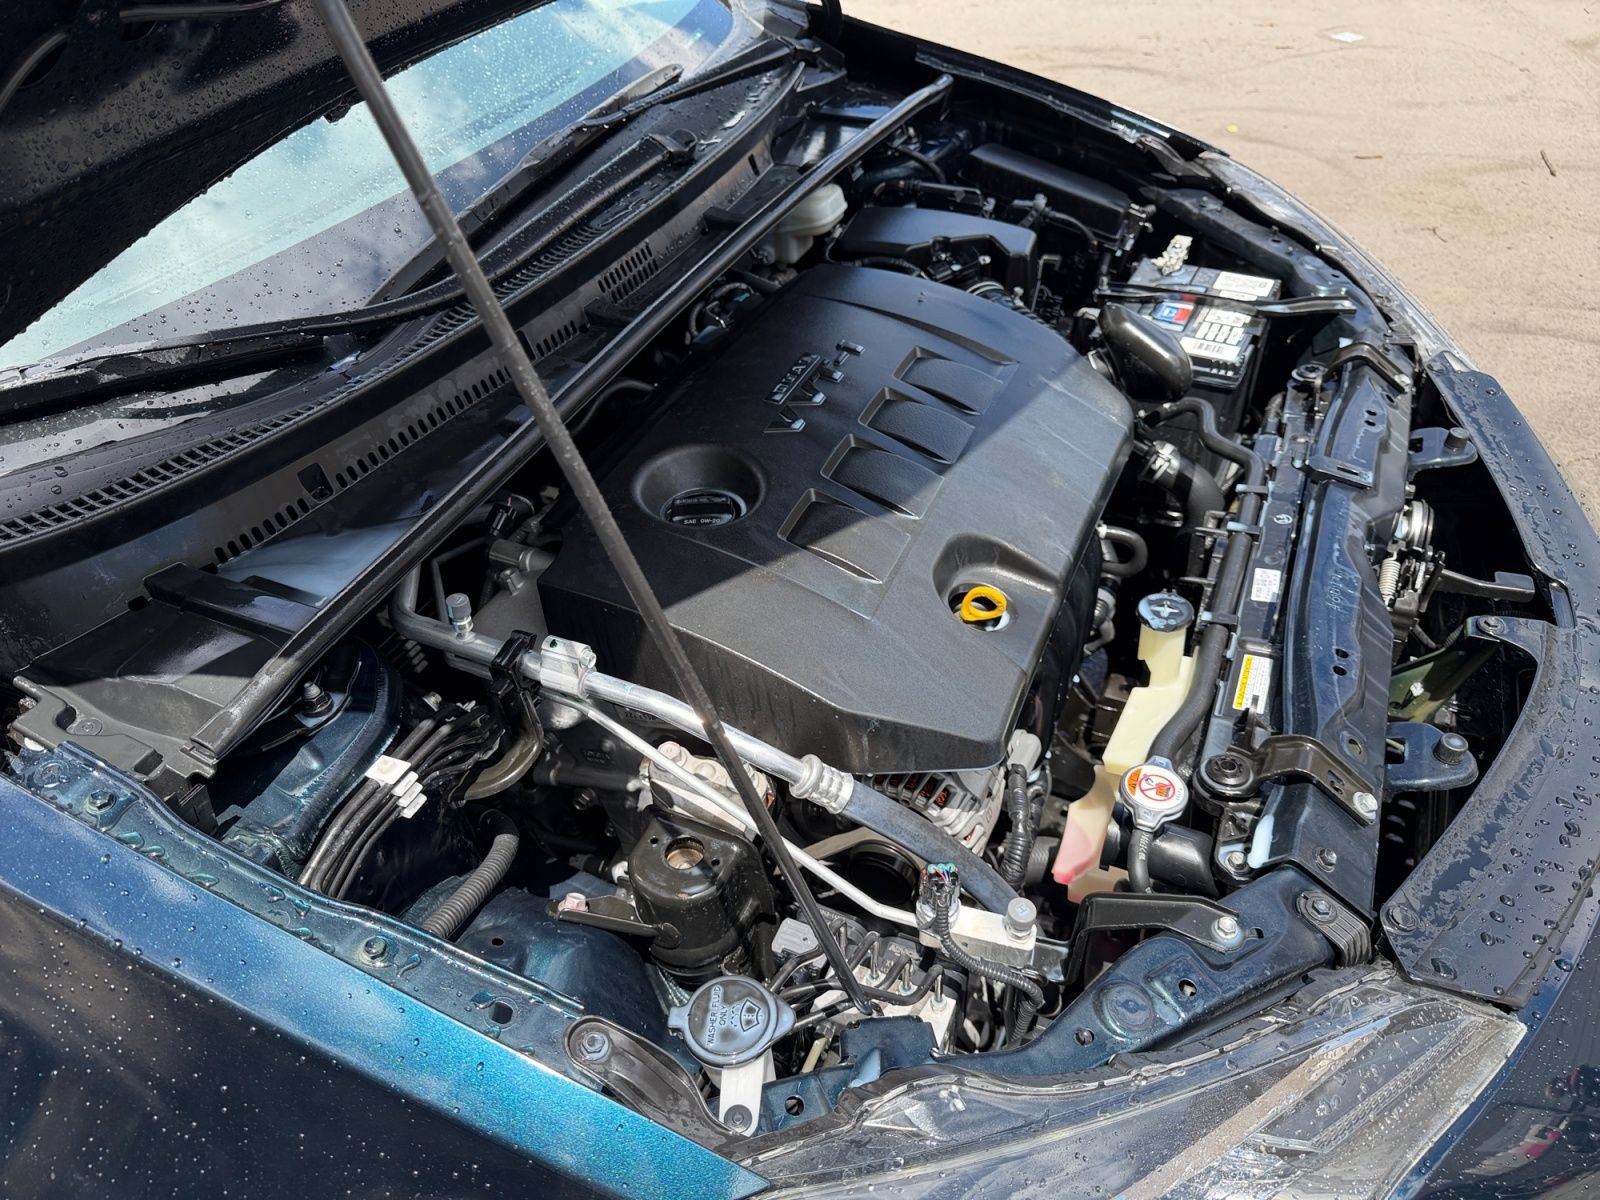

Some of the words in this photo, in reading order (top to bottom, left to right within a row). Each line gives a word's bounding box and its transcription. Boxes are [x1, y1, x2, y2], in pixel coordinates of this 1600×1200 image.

[706, 1011, 717, 1045] WASHER
[712, 986, 721, 1008] FLUID
[718, 1005, 728, 1026] ONLY
